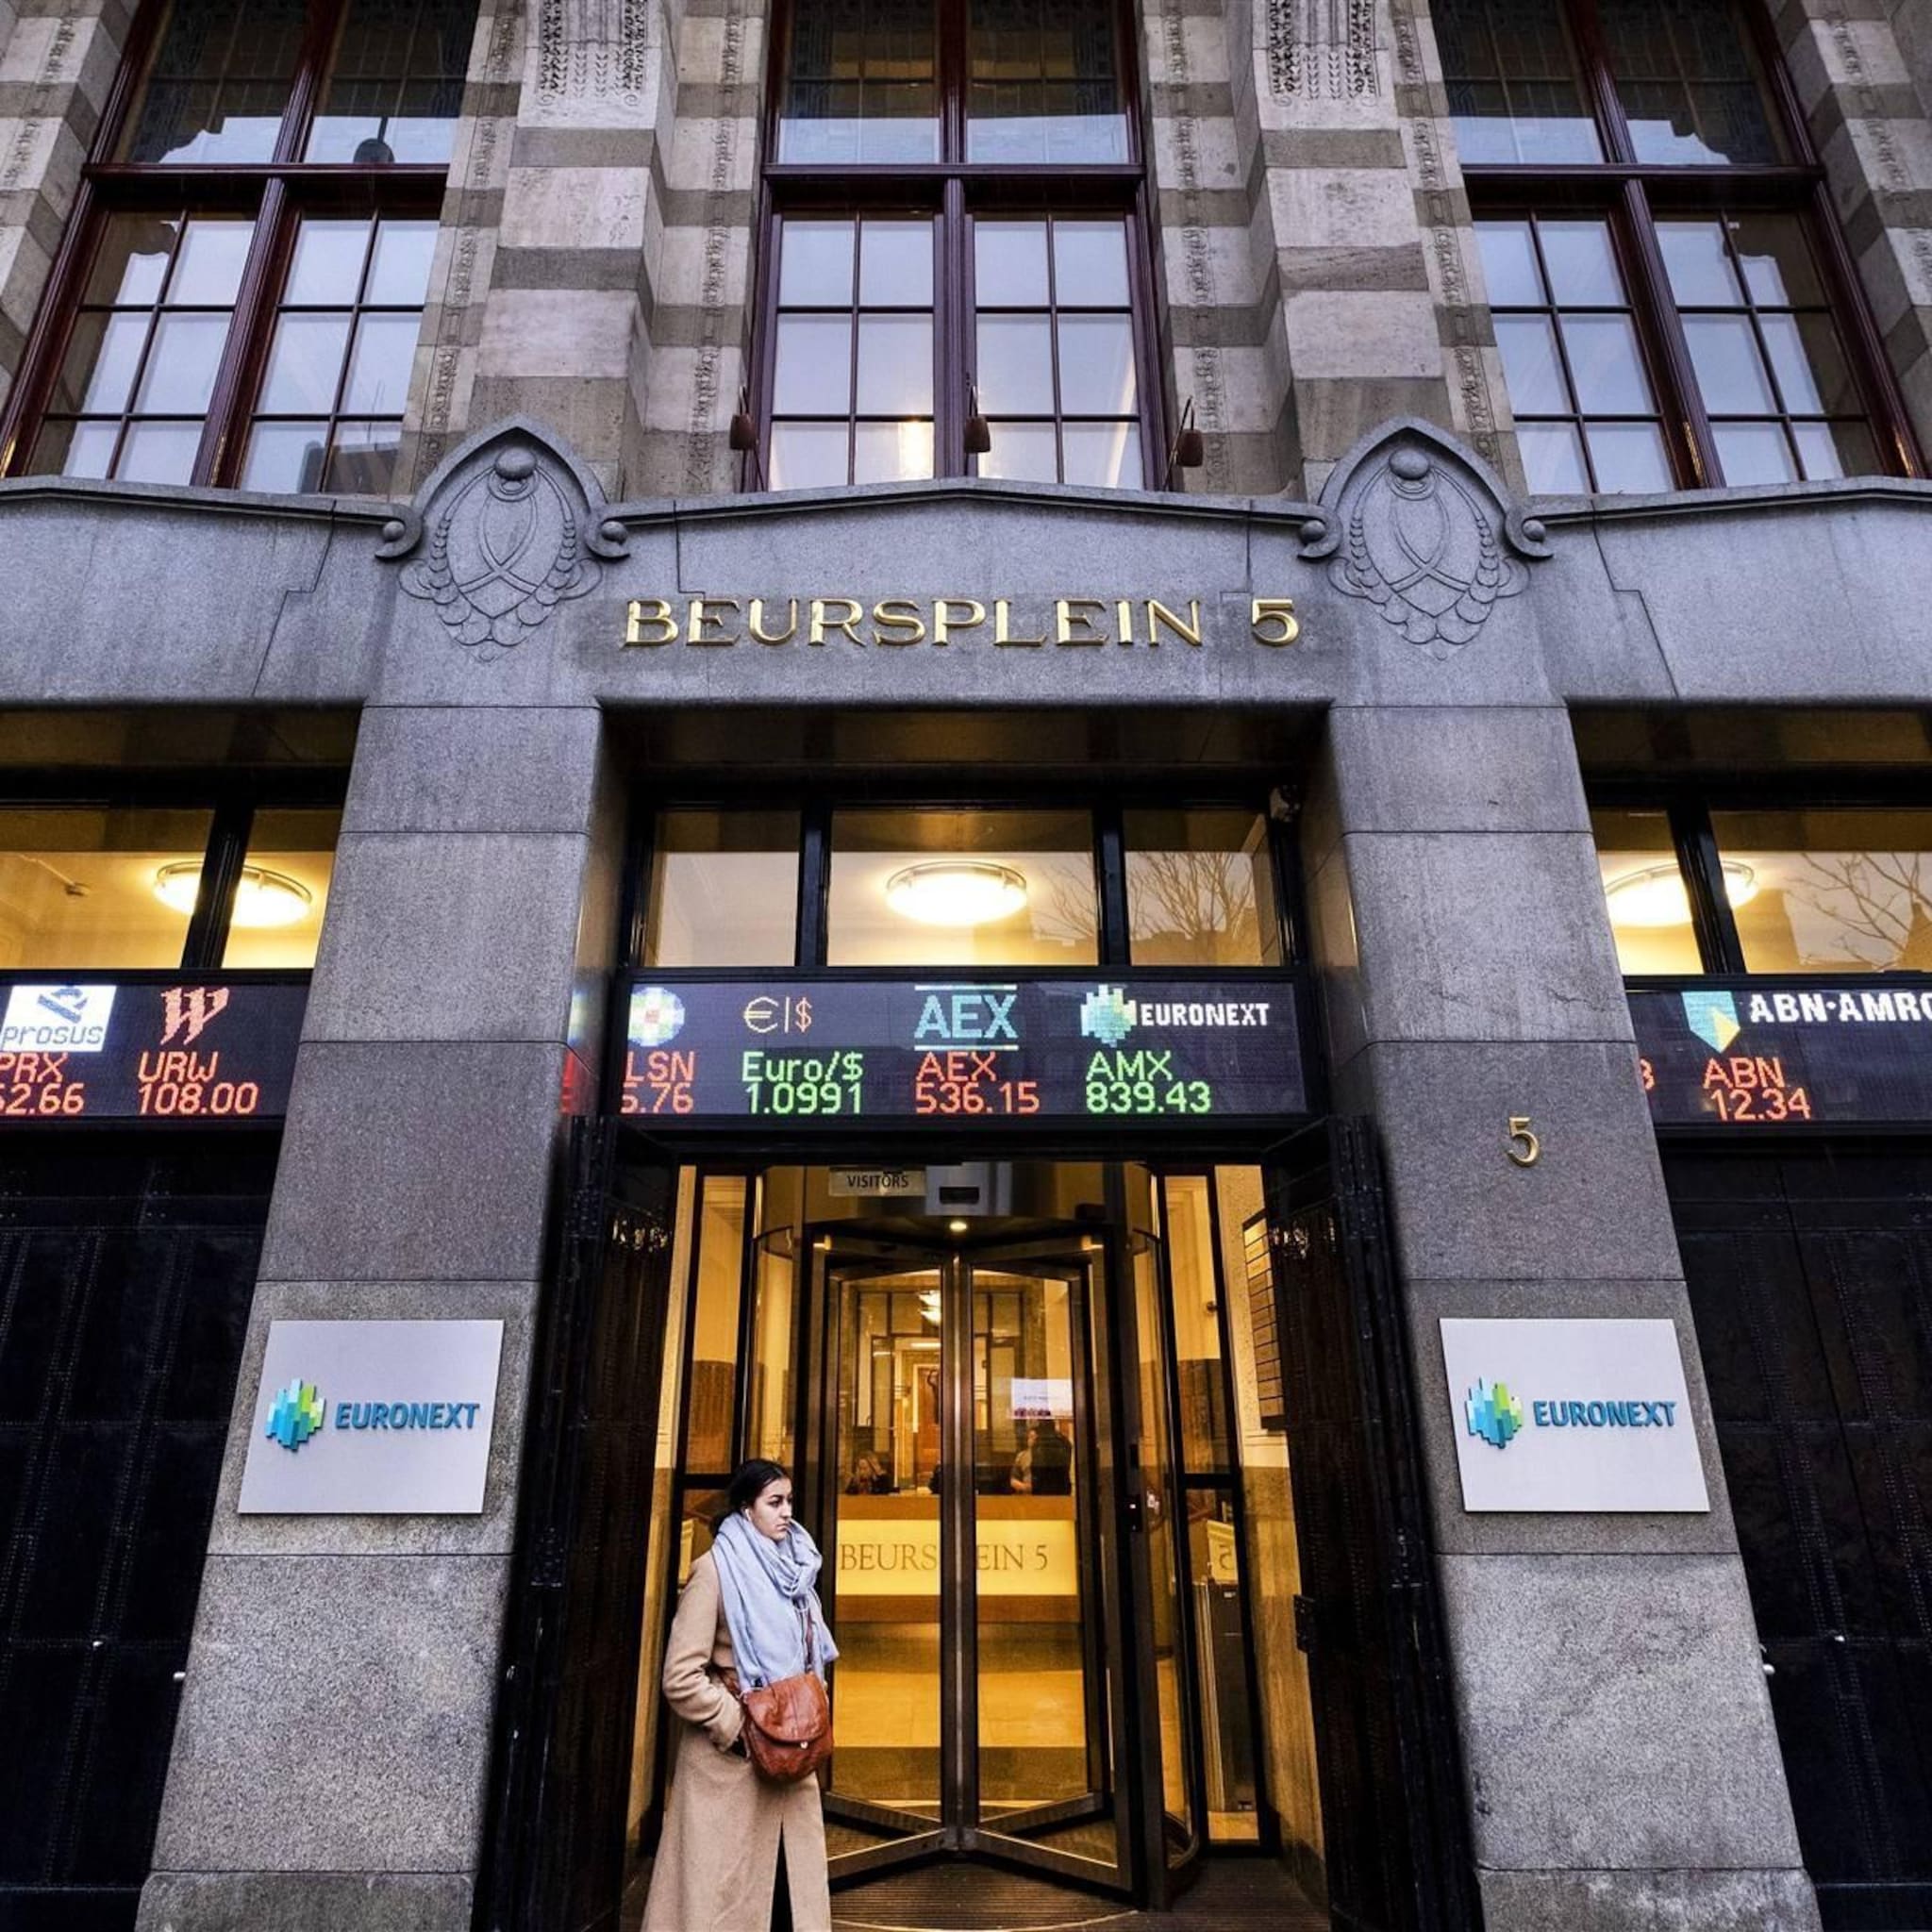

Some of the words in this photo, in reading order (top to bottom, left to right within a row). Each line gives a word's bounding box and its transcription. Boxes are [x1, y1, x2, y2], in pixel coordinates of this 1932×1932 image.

[623, 598, 1203, 647] BEURSPLEIN
[1251, 598, 1300, 647] 5
[914, 994, 1018, 1039] AEX
[1141, 1003, 1270, 1026] EURONEXT
[1, 1025, 104, 1050] prosus
[0, 1052, 69, 1083] PRX
[138, 1051, 219, 1082] URW
[625, 1051, 695, 1081] LSN
[741, 1051, 863, 1081] Euro/$
[916, 1051, 997, 1082] AEX
[1086, 1051, 1173, 1081] AMX
[1704, 1057, 1785, 1089] ABN
[0, 1083, 85, 1114] 2.66
[139, 1082, 259, 1115] 108.00
[621, 1082, 694, 1114] 5.76
[745, 1082, 860, 1114] 1.0991
[915, 1082, 1040, 1114] 536.15
[1086, 1082, 1212, 1113] 839.43
[1710, 1088, 1811, 1120] 12.34
[1507, 1116, 1540, 1168] 5
[847, 1174, 909, 1189] VISITORS
[335, 1402, 479, 1429] EURONEXT
[1532, 1400, 1676, 1427] EURONEXT
[840, 1543, 1024, 1571] BEURSEIN
[1035, 1543, 1048, 1571] 5
